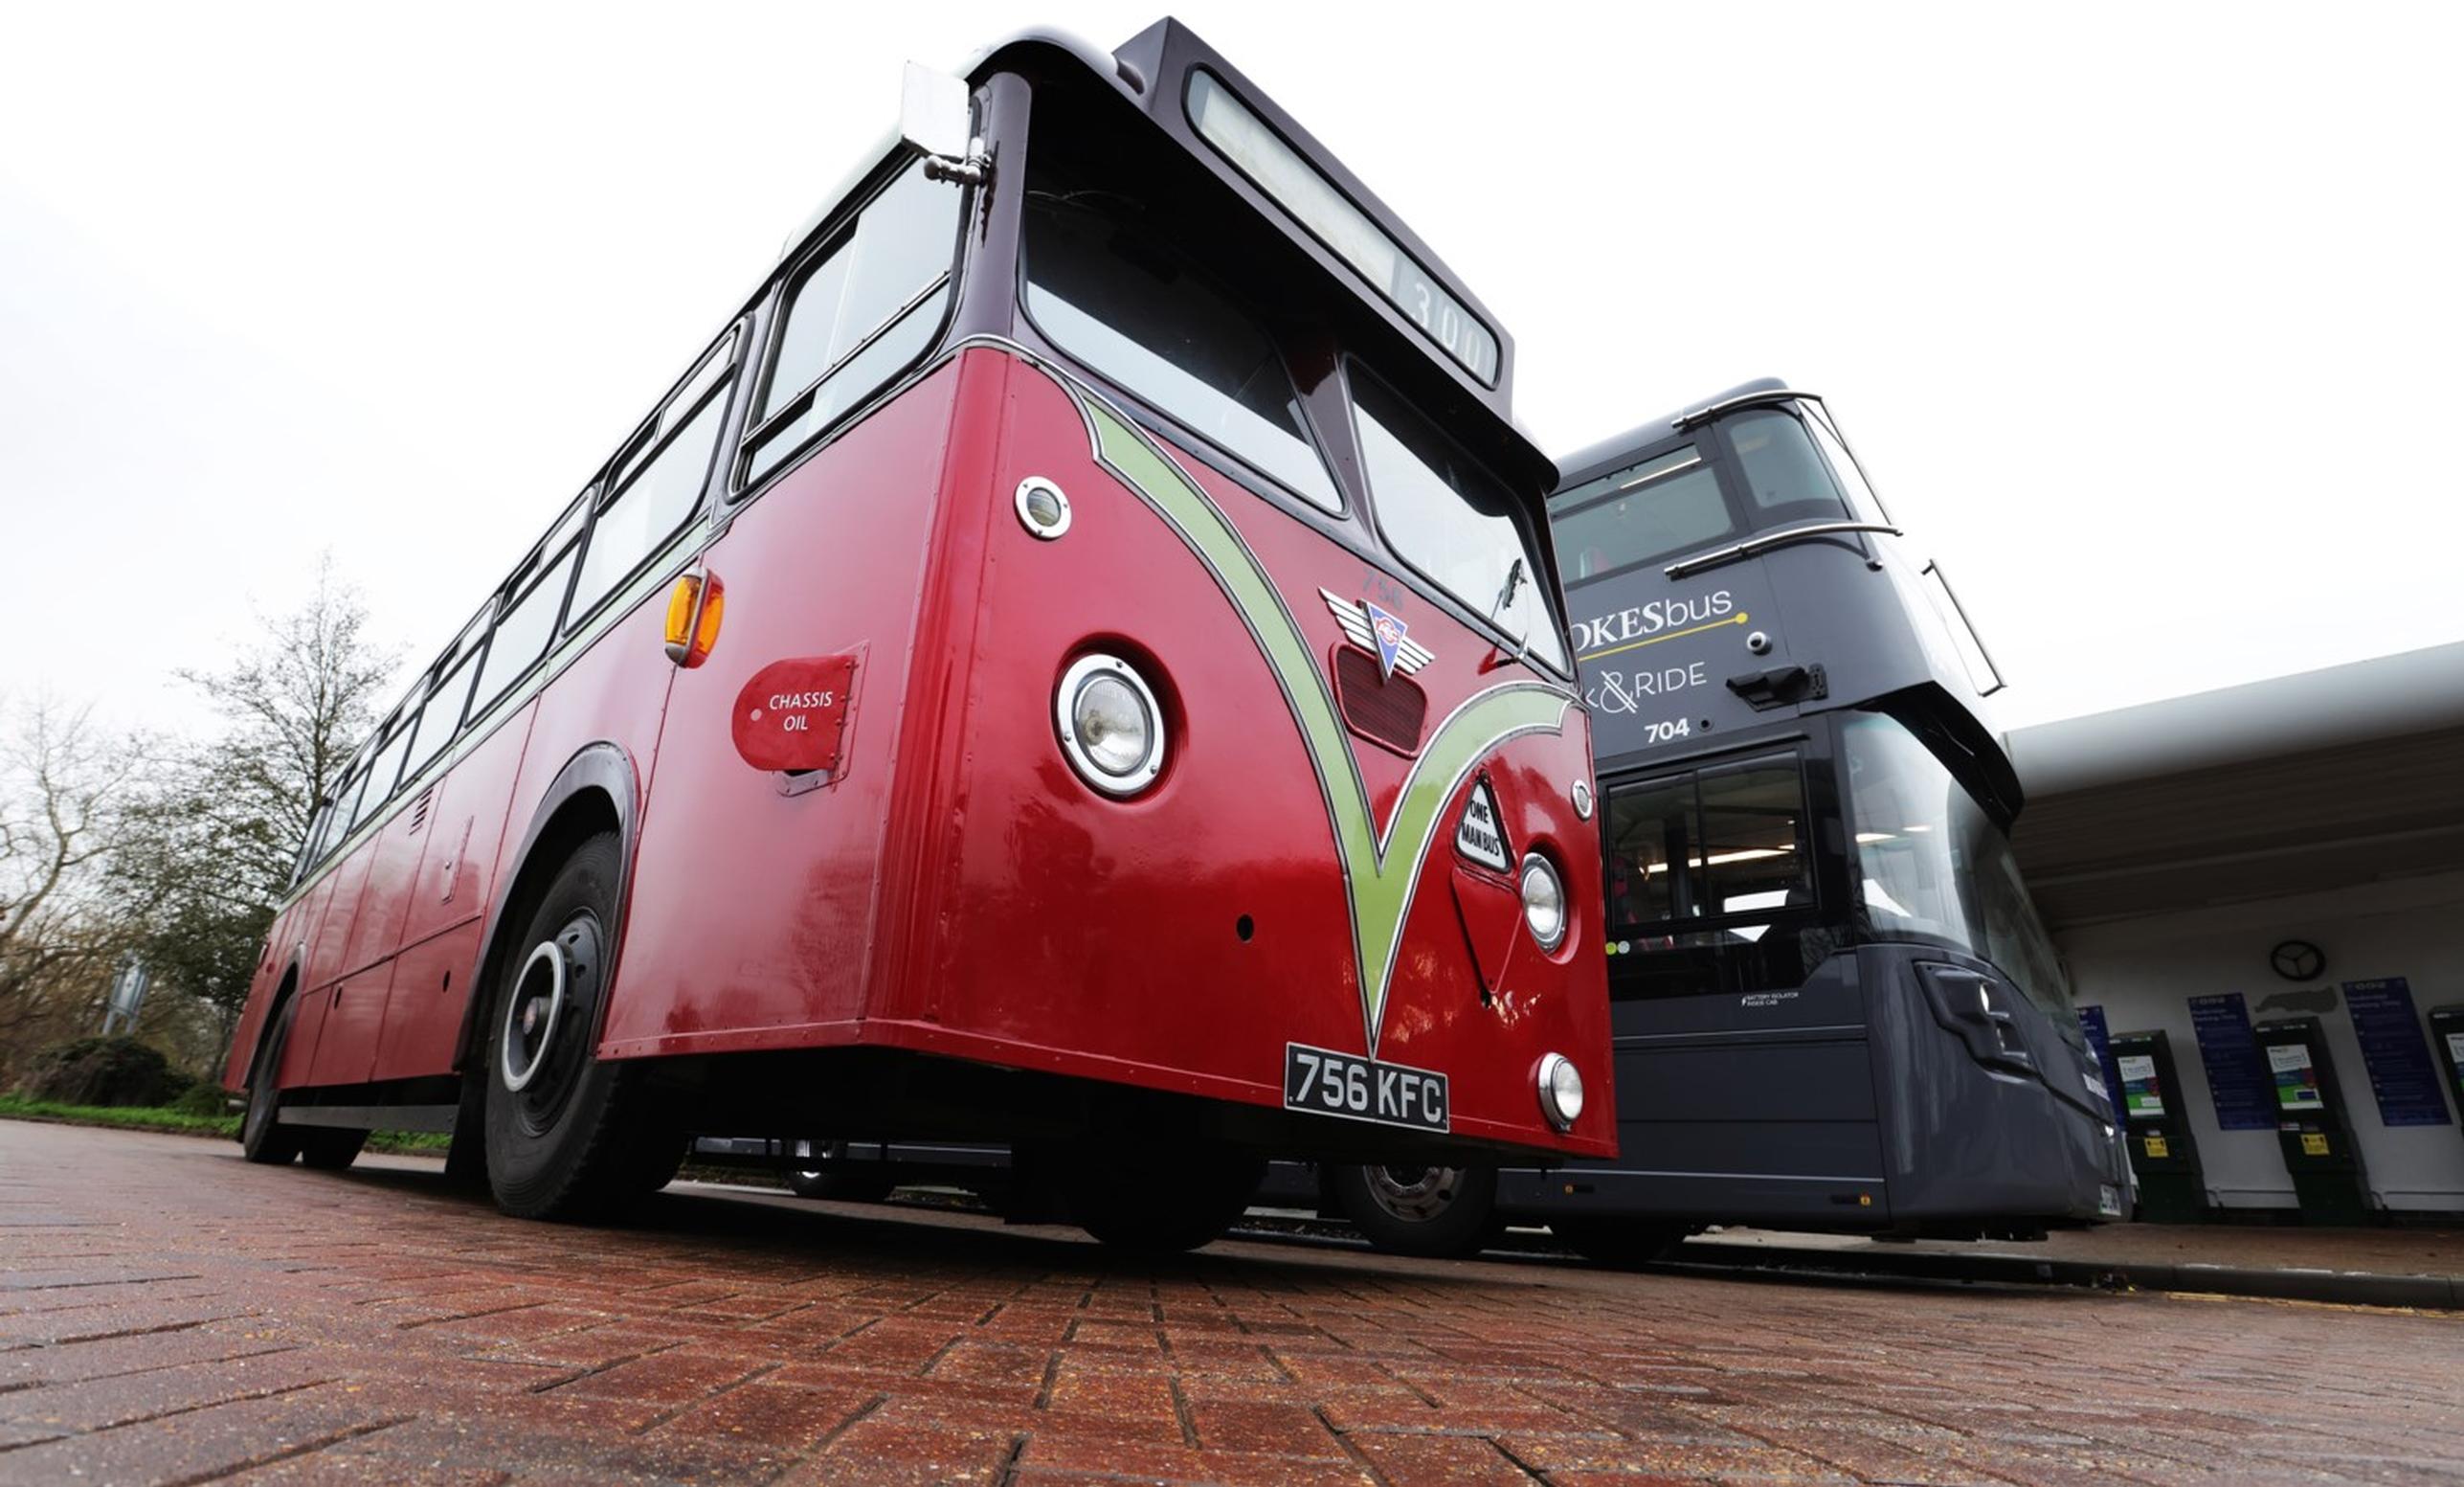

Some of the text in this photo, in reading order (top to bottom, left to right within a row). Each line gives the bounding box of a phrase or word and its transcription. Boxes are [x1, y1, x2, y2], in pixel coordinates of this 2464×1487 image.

[1411, 283, 1481, 372] 300
[770, 691, 833, 710] CHASSIS
[783, 715, 808, 732] OIL
[1644, 718, 1691, 743] 704
[1469, 800, 1489, 823] ONE
[1296, 1053, 1442, 1123] 756 KFC
